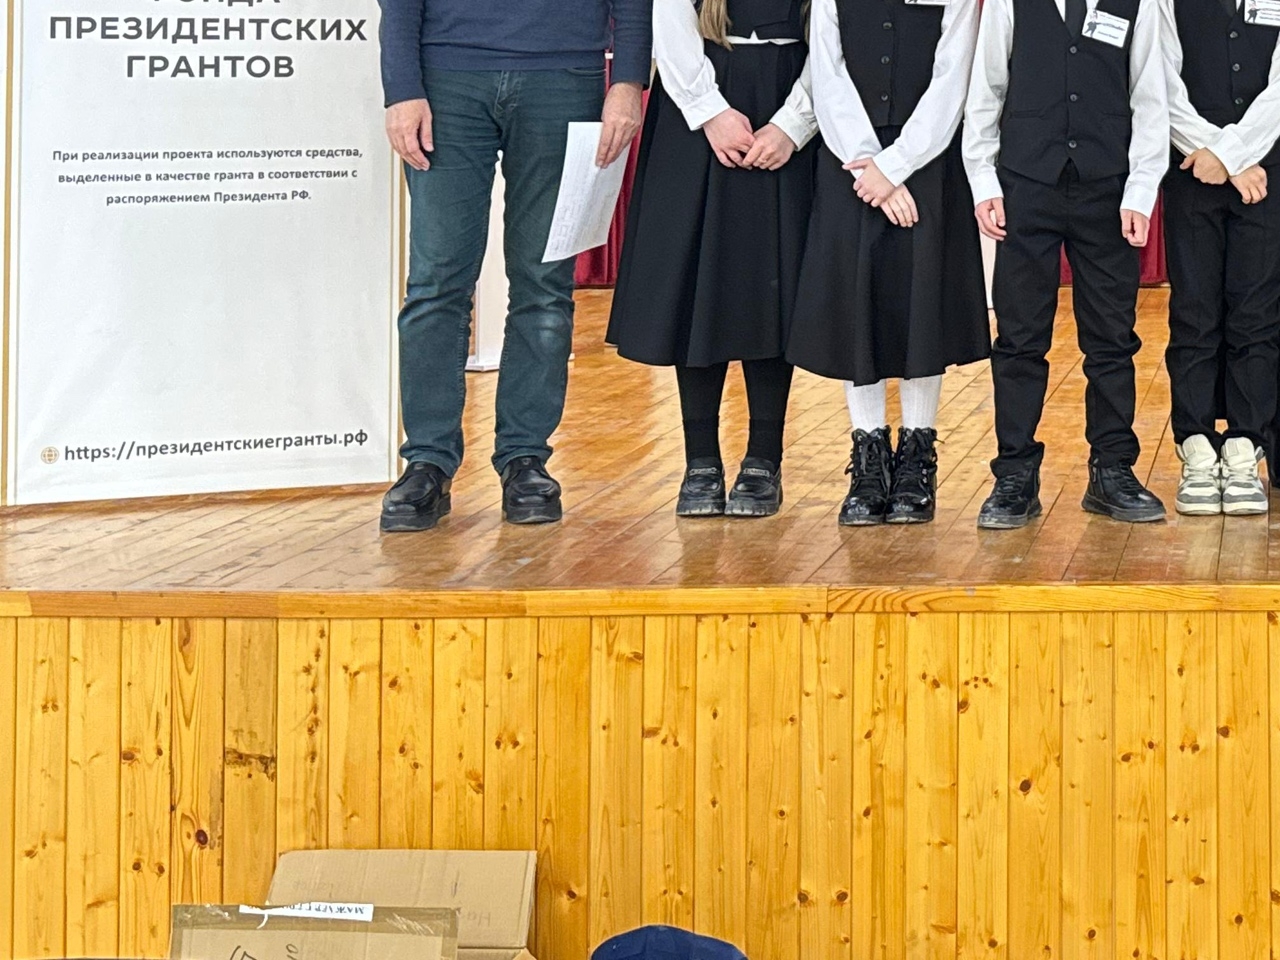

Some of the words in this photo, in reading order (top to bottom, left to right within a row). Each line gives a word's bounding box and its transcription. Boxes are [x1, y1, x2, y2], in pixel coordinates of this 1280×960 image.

[50, 16, 368, 44] ПРЕЗИДЕНТСКИХ
[127, 55, 295, 78] ГРАНТОВ
[53, 150, 78, 163] При
[82, 151, 159, 163] реализации
[163, 150, 213, 161] проекта
[217, 149, 302, 161] используются
[305, 147, 363, 160] средства,
[58, 173, 142, 184] выделенные
[145, 173, 152, 182] в
[155, 172, 211, 182] качестве
[214, 171, 254, 182] гранта
[258, 171, 265, 180] в
[268, 169, 349, 180] соответствии
[351, 169, 358, 178] с
[106, 193, 211, 206] распоряжением
[214, 191, 288, 204] Президента
[291, 189, 312, 201] РФ.
[64, 429, 369, 462] https://президентскиегранты.рф
